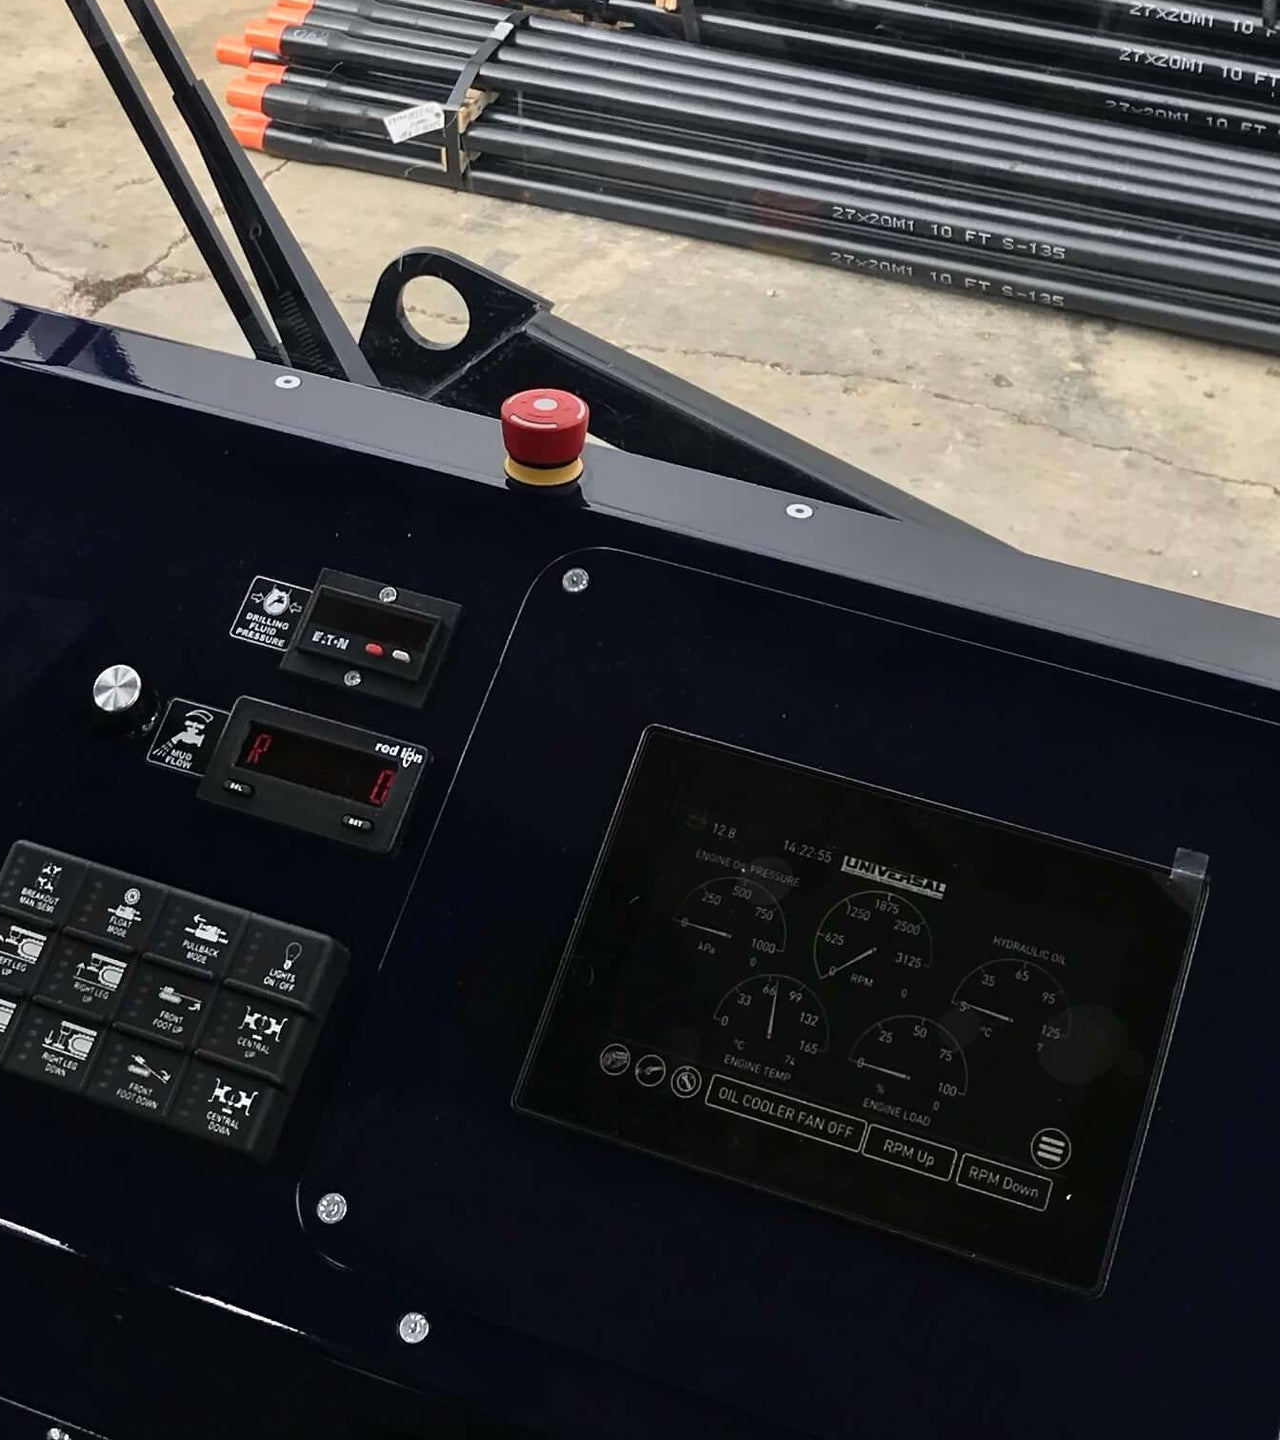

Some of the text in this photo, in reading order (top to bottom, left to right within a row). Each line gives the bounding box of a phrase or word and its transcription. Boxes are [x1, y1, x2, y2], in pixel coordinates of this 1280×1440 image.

[1233, 18, 1254, 36] 10
[1221, 65, 1243, 82] 10
[1254, 71, 1280, 88] FT
[930, 223, 952, 239] 10
[965, 229, 991, 245] FT
[1002, 236, 1066, 260] S-135
[929, 270, 952, 286] 10
[964, 277, 991, 292] FT
[1001, 285, 1064, 308] S-135
[245, 612, 289, 631] DRILLING
[248, 621, 277, 636] FLUID
[235, 627, 285, 648] PRESSURE
[171, 747, 193, 761] MUD
[165, 755, 193, 770] FLOW
[695, 847, 732, 869] ENGINE
[749, 864, 800, 888] PRESSURE
[843, 855, 947, 894] UNIVERSAL
[21, 887, 60, 906] BREAKOUT
[702, 889, 722, 906] 250
[732, 885, 752, 901] 500
[19, 895, 35, 908] MAN
[875, 899, 900, 915] 1875
[755, 906, 774, 921] 750
[846, 904, 871, 921] 1250
[109, 915, 132, 929] FLOAT
[893, 919, 920, 936] 2500
[106, 924, 127, 938] MODE
[824, 931, 845, 946] 625
[182, 939, 220, 958] PULLBACK
[751, 937, 776, 955] 1000
[992, 934, 1067, 966] HYDRAULIC OIL
[186, 951, 208, 965] MODE
[748, 956, 758, 968] 0
[894, 951, 922, 969] 3125
[1, 967, 13, 976] UP
[11, 961, 28, 973] LEG
[269, 968, 296, 984] LIGHTS
[850, 973, 874, 988] RPM
[981, 973, 996, 988] 35
[1014, 969, 1030, 983] 65
[73, 980, 110, 1000] RIGHT LEG
[762, 984, 776, 997] 66
[788, 990, 803, 1003] 99
[900, 988, 909, 999] 0
[1041, 991, 1056, 1005] 95
[81, 994, 93, 1003] UP
[737, 992, 752, 1007] 33
[159, 1010, 184, 1025] FRONT
[720, 1015, 730, 1027] 0
[799, 1011, 819, 1028] 132
[152, 1018, 185, 1035] FOOT UP
[912, 1024, 928, 1039] 50
[1041, 1024, 1061, 1039] 125
[878, 1029, 894, 1044] 25
[236, 1036, 271, 1056] CENTRAL
[799, 1039, 819, 1055] 165
[41, 1051, 79, 1071] RIGHT LEG
[244, 1050, 257, 1059] UP
[938, 1047, 953, 1062] 75
[44, 1062, 67, 1078] DOWN
[723, 1053, 792, 1082] ENGINE TEMP
[128, 1081, 153, 1097] FRONT
[938, 1081, 958, 1098] 100
[115, 1087, 160, 1111] FOOT DOWN
[932, 1100, 941, 1112] 0
[718, 1086, 855, 1140] OIL COOLER FAN OFF
[862, 1096, 932, 1127] ENGINE LOAD
[206, 1110, 240, 1131] CENTRAL
[208, 1121, 231, 1137] DOWN
[882, 1138, 936, 1168] RPM Up
[967, 1165, 1040, 1199] RPM Down
